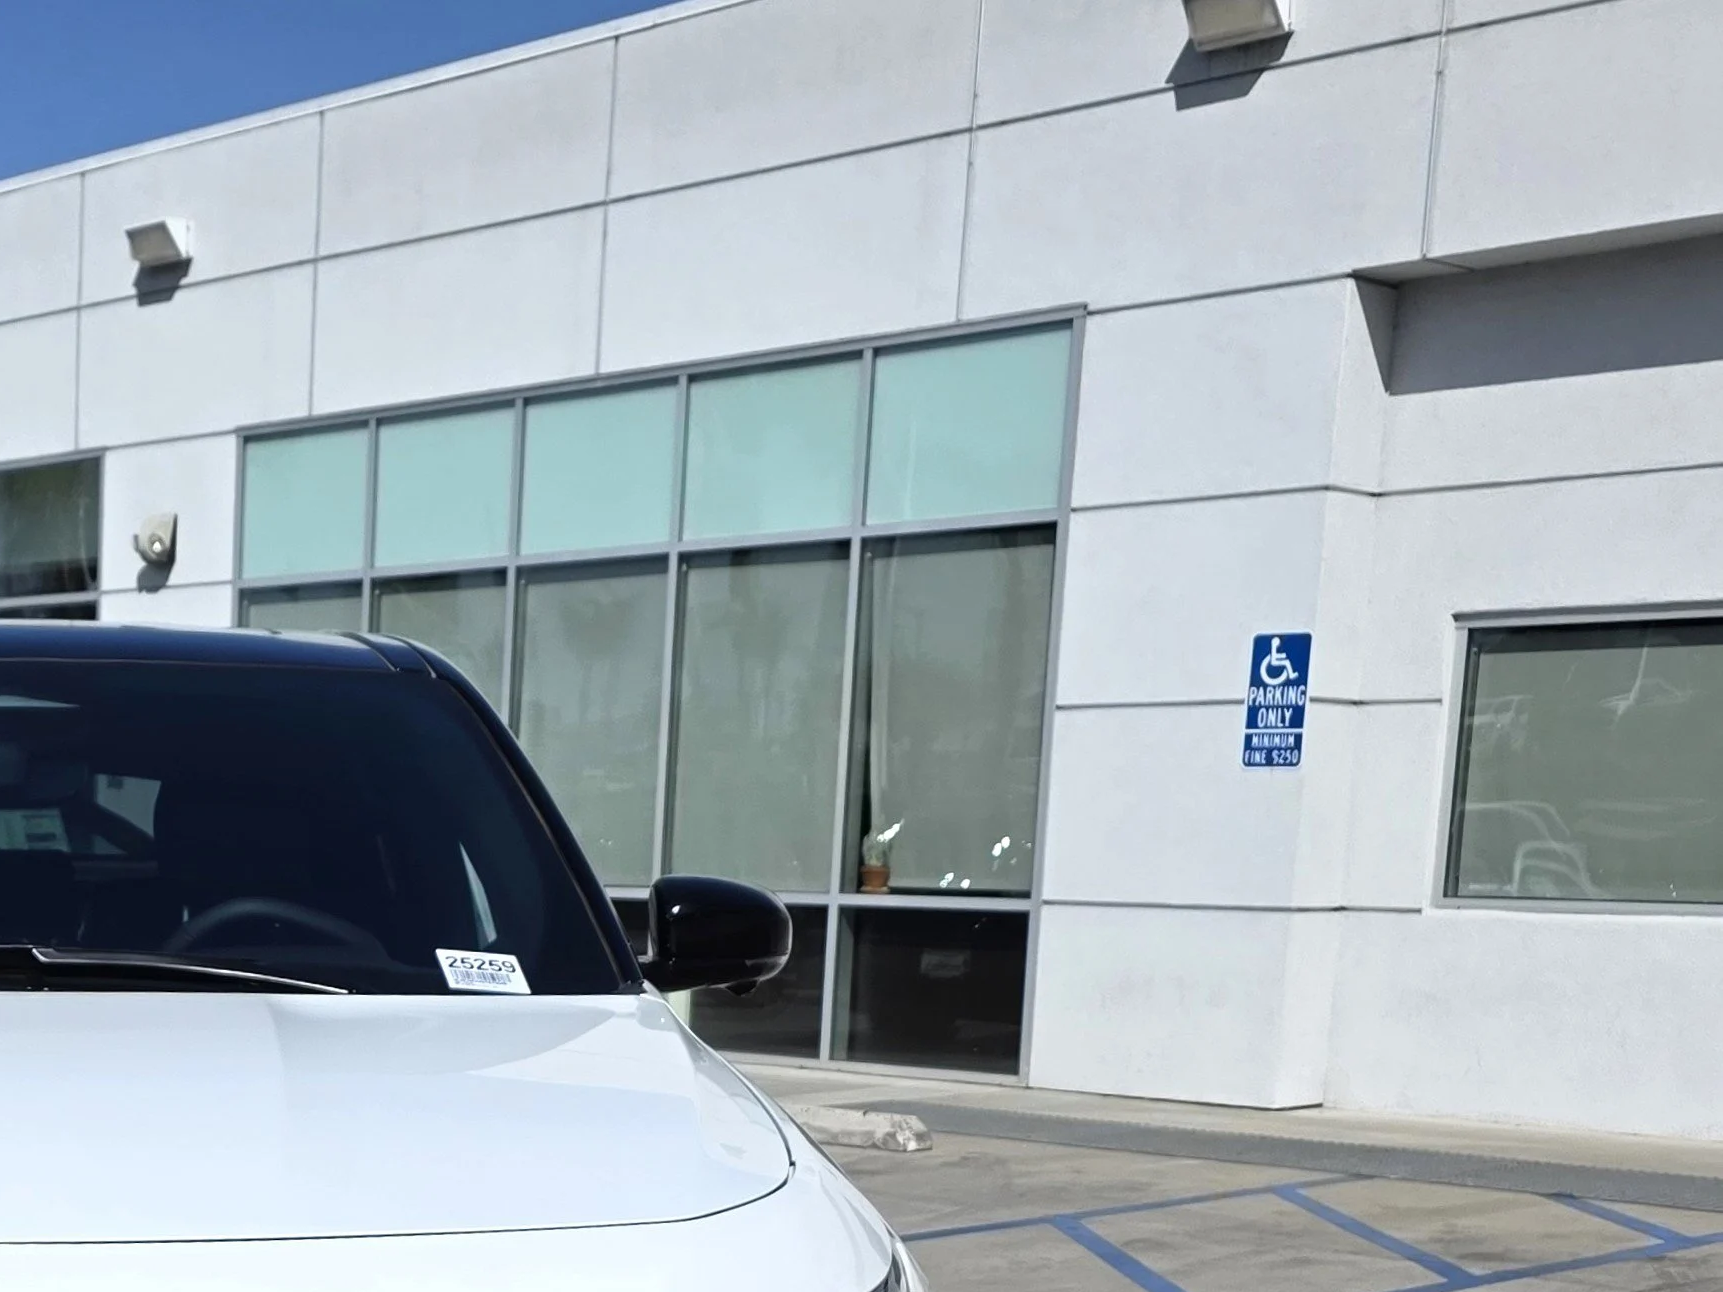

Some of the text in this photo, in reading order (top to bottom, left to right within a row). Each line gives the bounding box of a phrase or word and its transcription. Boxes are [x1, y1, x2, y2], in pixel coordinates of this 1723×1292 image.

[1248, 685, 1306, 706] PARKING
[1257, 707, 1293, 728] ONLY
[1251, 733, 1295, 748] MINIMUM
[1244, 749, 1299, 765] FINE $250
[445, 956, 517, 973] 25259
